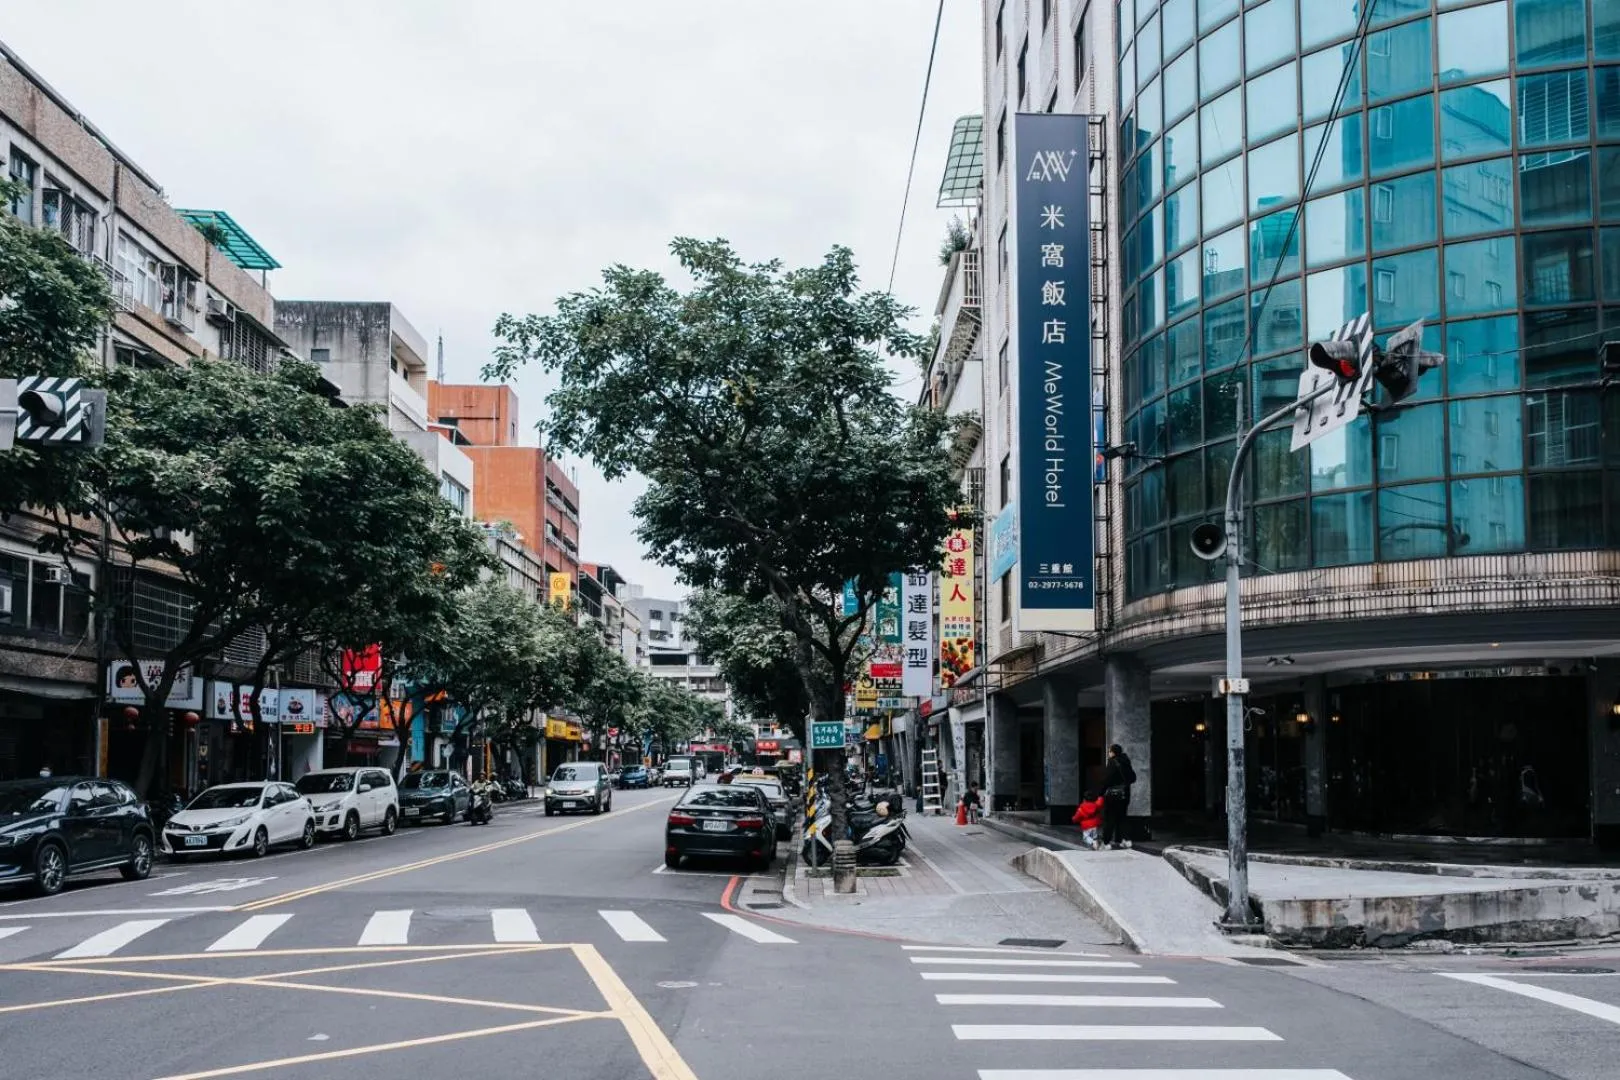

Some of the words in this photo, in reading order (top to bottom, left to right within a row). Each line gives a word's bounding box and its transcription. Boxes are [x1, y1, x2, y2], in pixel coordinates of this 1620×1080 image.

[1040, 204, 1067, 344] 米窩飯店
[1044, 361, 1065, 451] MeWorld
[1045, 459, 1066, 507] Hotel
[1028, 581, 1084, 590] 02-2977-5678
[1039, 563, 1073, 574] 三重館
